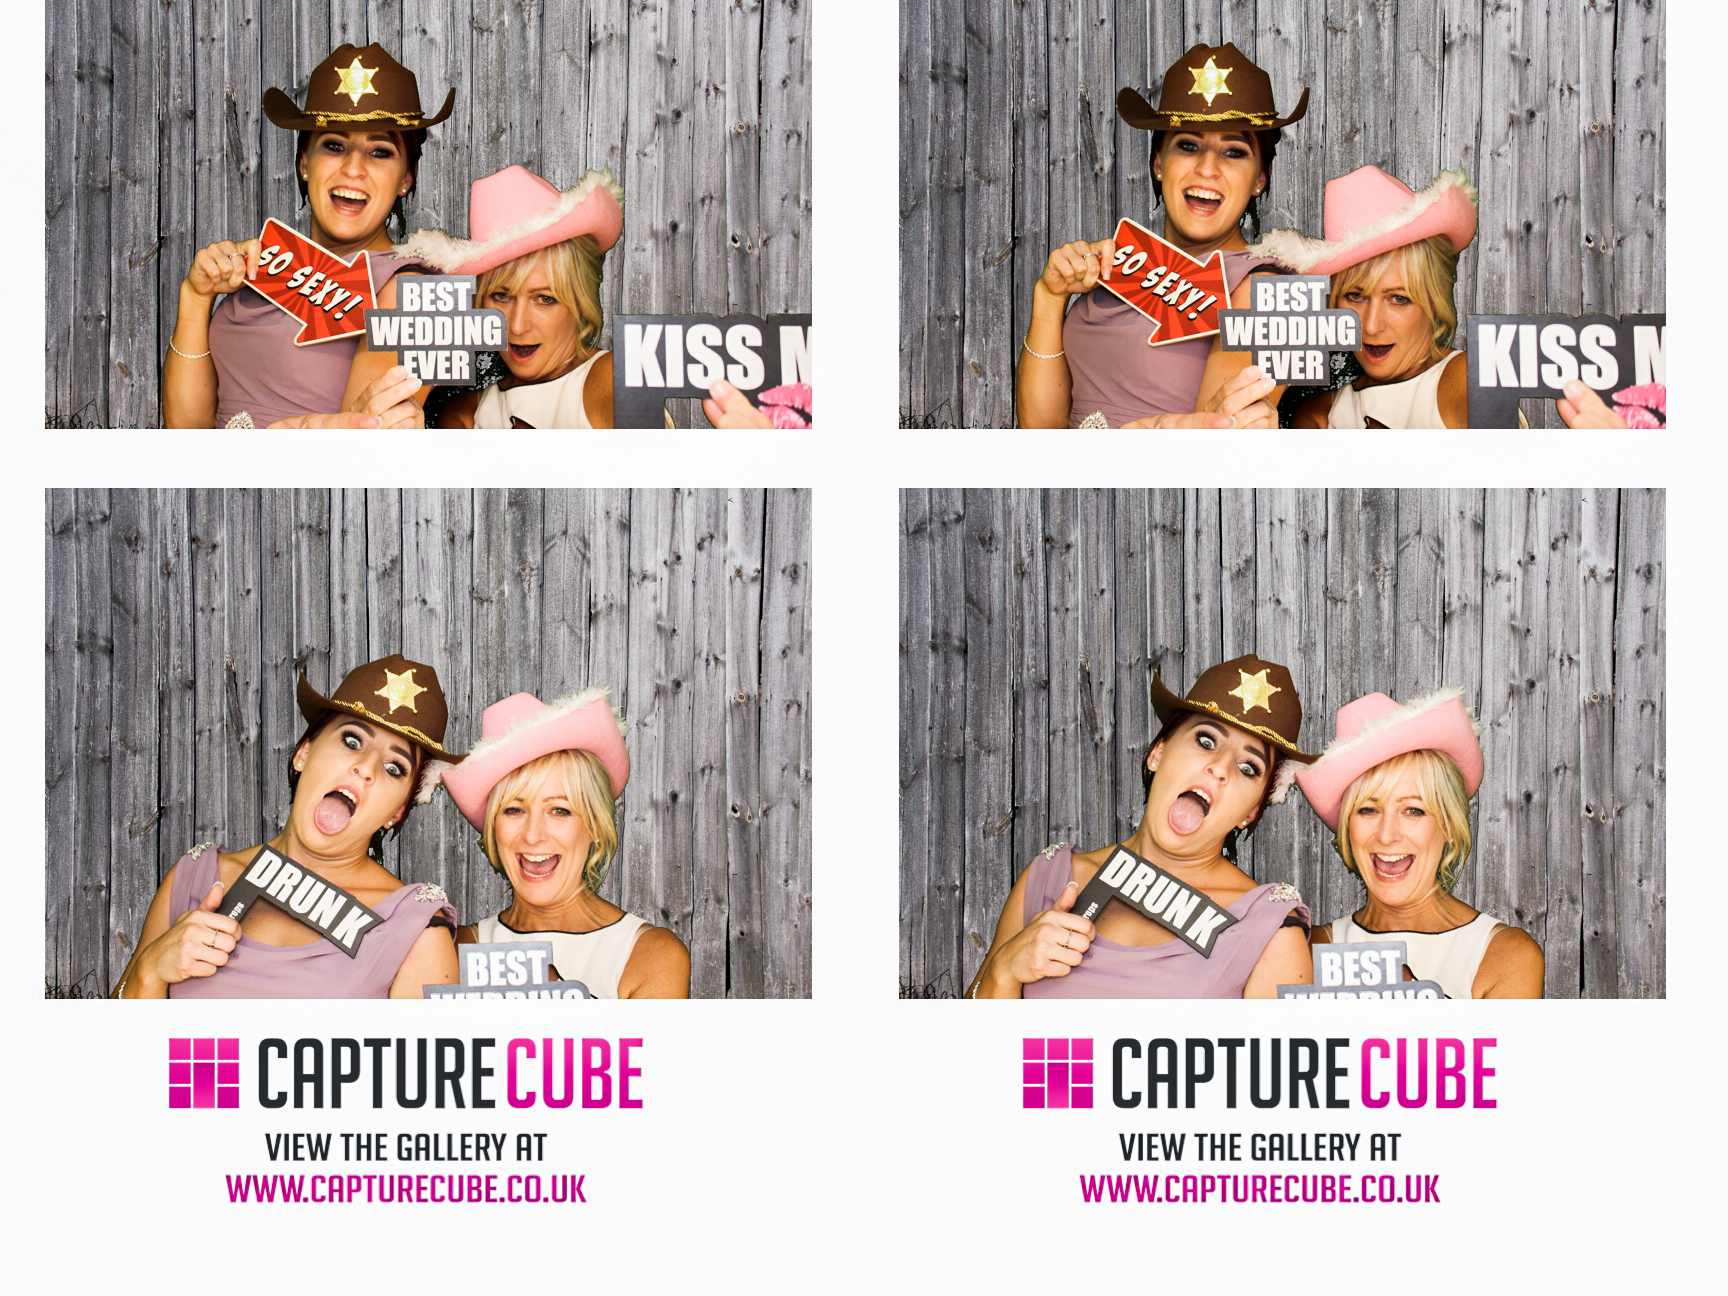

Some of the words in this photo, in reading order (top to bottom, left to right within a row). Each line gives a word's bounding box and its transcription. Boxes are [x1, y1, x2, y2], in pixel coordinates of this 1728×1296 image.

[258, 245, 294, 276] SO
[286, 265, 364, 321] SEXY!
[402, 281, 471, 312] BEST
[1112, 245, 1148, 276] SO
[1140, 265, 1218, 321] SEXY!
[1256, 281, 1325, 312] BEST
[370, 315, 502, 346] WEDDING
[1224, 315, 1356, 346] WEDDING
[403, 350, 470, 380] EVER
[624, 323, 765, 391] KISS
[1257, 350, 1324, 380] EVER
[1478, 323, 1619, 391] KISS
[467, 950, 547, 987] BEST
[1321, 950, 1401, 987] BEST
